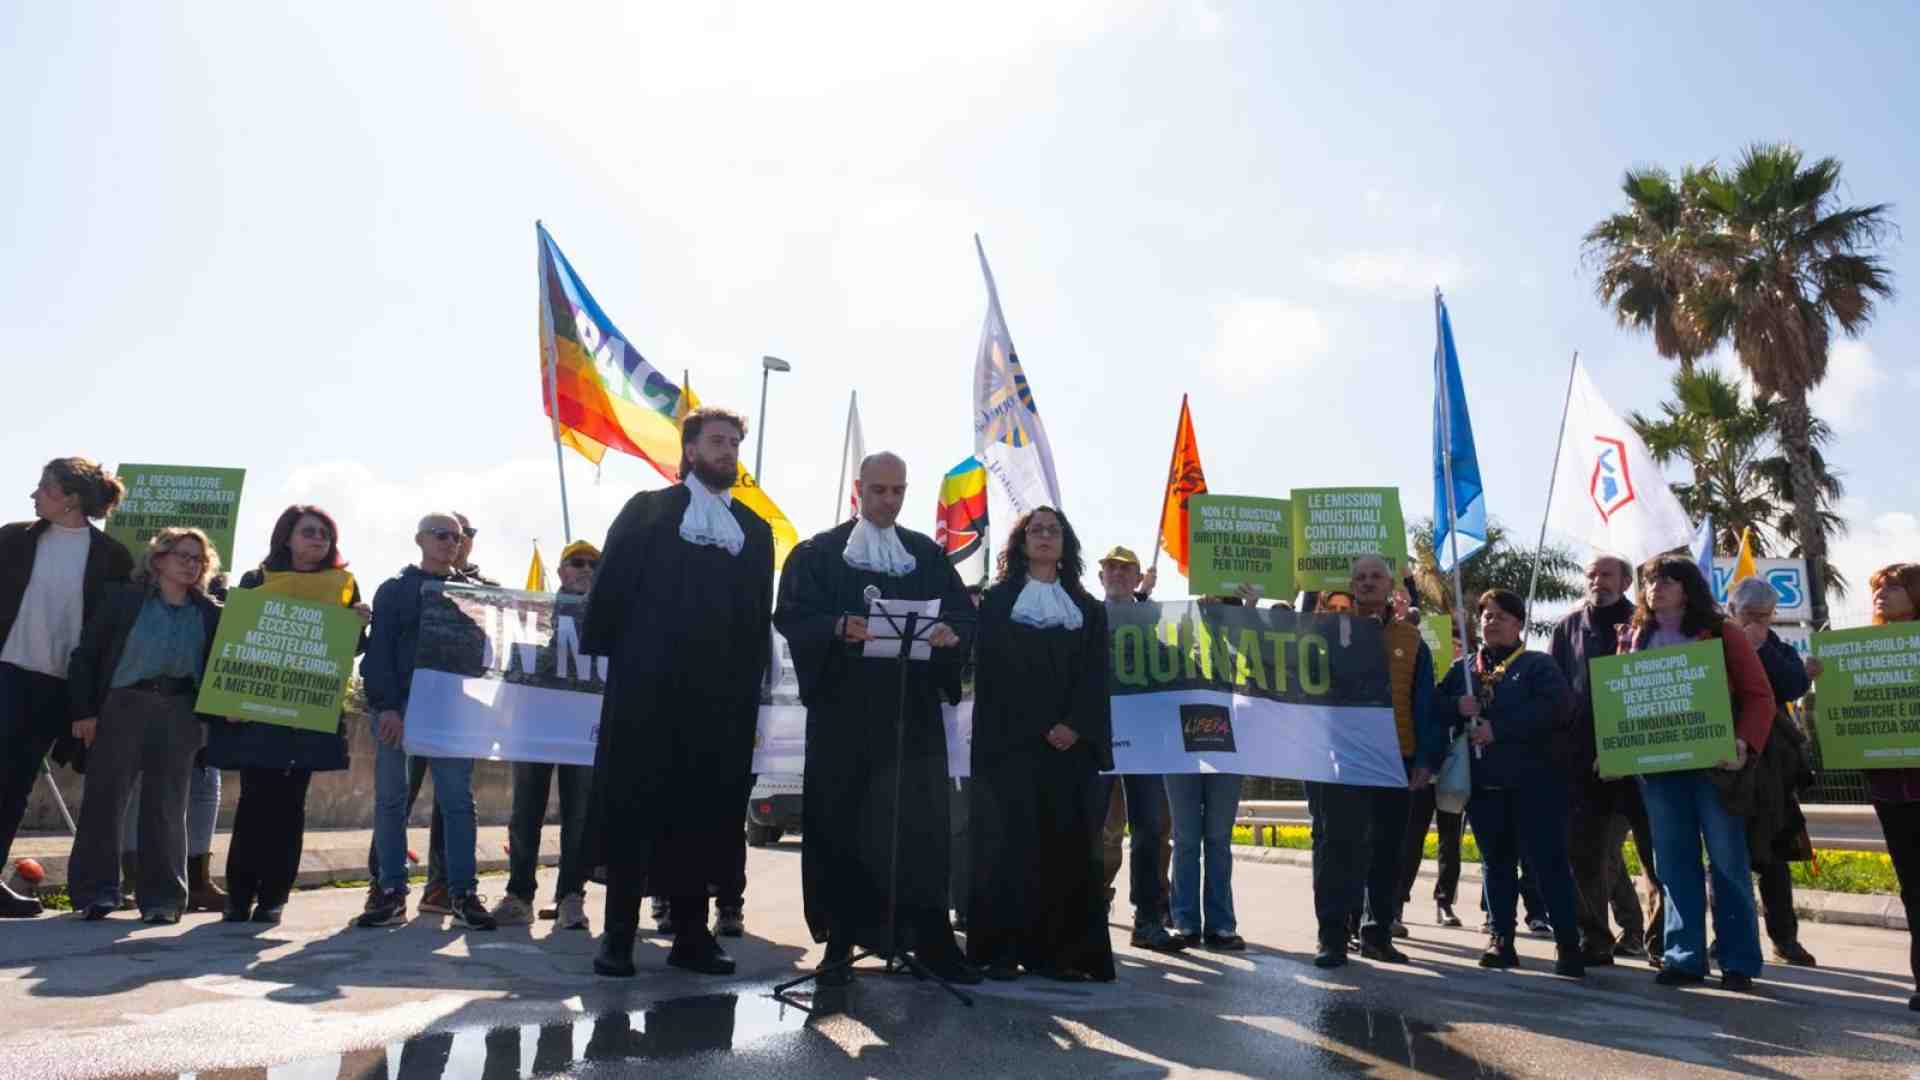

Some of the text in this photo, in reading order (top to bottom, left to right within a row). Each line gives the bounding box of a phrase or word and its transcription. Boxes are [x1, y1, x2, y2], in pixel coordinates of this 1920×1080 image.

[150, 475, 221, 489] DEPURATORE
[157, 490, 234, 503] SEQUESTRATO
[1308, 493, 1382, 508] LE EMISSIONI
[178, 502, 230, 515] SIMBOLO
[1200, 505, 1221, 517] NON
[1239, 507, 1282, 521] GIUSTIZIA
[1311, 509, 1381, 523] INDUSTRIALI
[149, 516, 215, 528] TERRITORIO
[1204, 518, 1234, 531] SENZA
[1193, 531, 1289, 548] DIRITTO ALLA SALUTE
[1304, 525, 1388, 540] CONTINUANO A
[1223, 545, 1233, 558] AL
[1235, 546, 1272, 560] LAVORO
[1213, 558, 1232, 571] PER
[1297, 558, 1349, 571] BONIFICA
[264, 601, 287, 616] DAL
[257, 616, 323, 641] ECCESSI DI
[245, 630, 329, 657] MESOTELIOMI
[222, 643, 234, 658] E
[236, 644, 282, 666] TUMORI
[1622, 654, 1688, 676] IL PRINCIPIO
[214, 657, 341, 690] L'AMIANTO CONTINUA
[1630, 671, 1675, 689] INQUINA
[212, 675, 337, 707] A MIETERE VITTIME!
[1623, 682, 1694, 704] DEVE ESSERE
[1853, 686, 1920, 702] ACCELERARE
[1827, 705, 1839, 720] LE
[1841, 702, 1897, 719] BONIFICHE
[1617, 711, 1706, 734] GLI INQUINATORI
[1835, 722, 1847, 736] DI
[1848, 719, 1898, 736] GIUSTIZIA
[1602, 724, 1728, 751] DEVONO AGIRE SUBITO!
